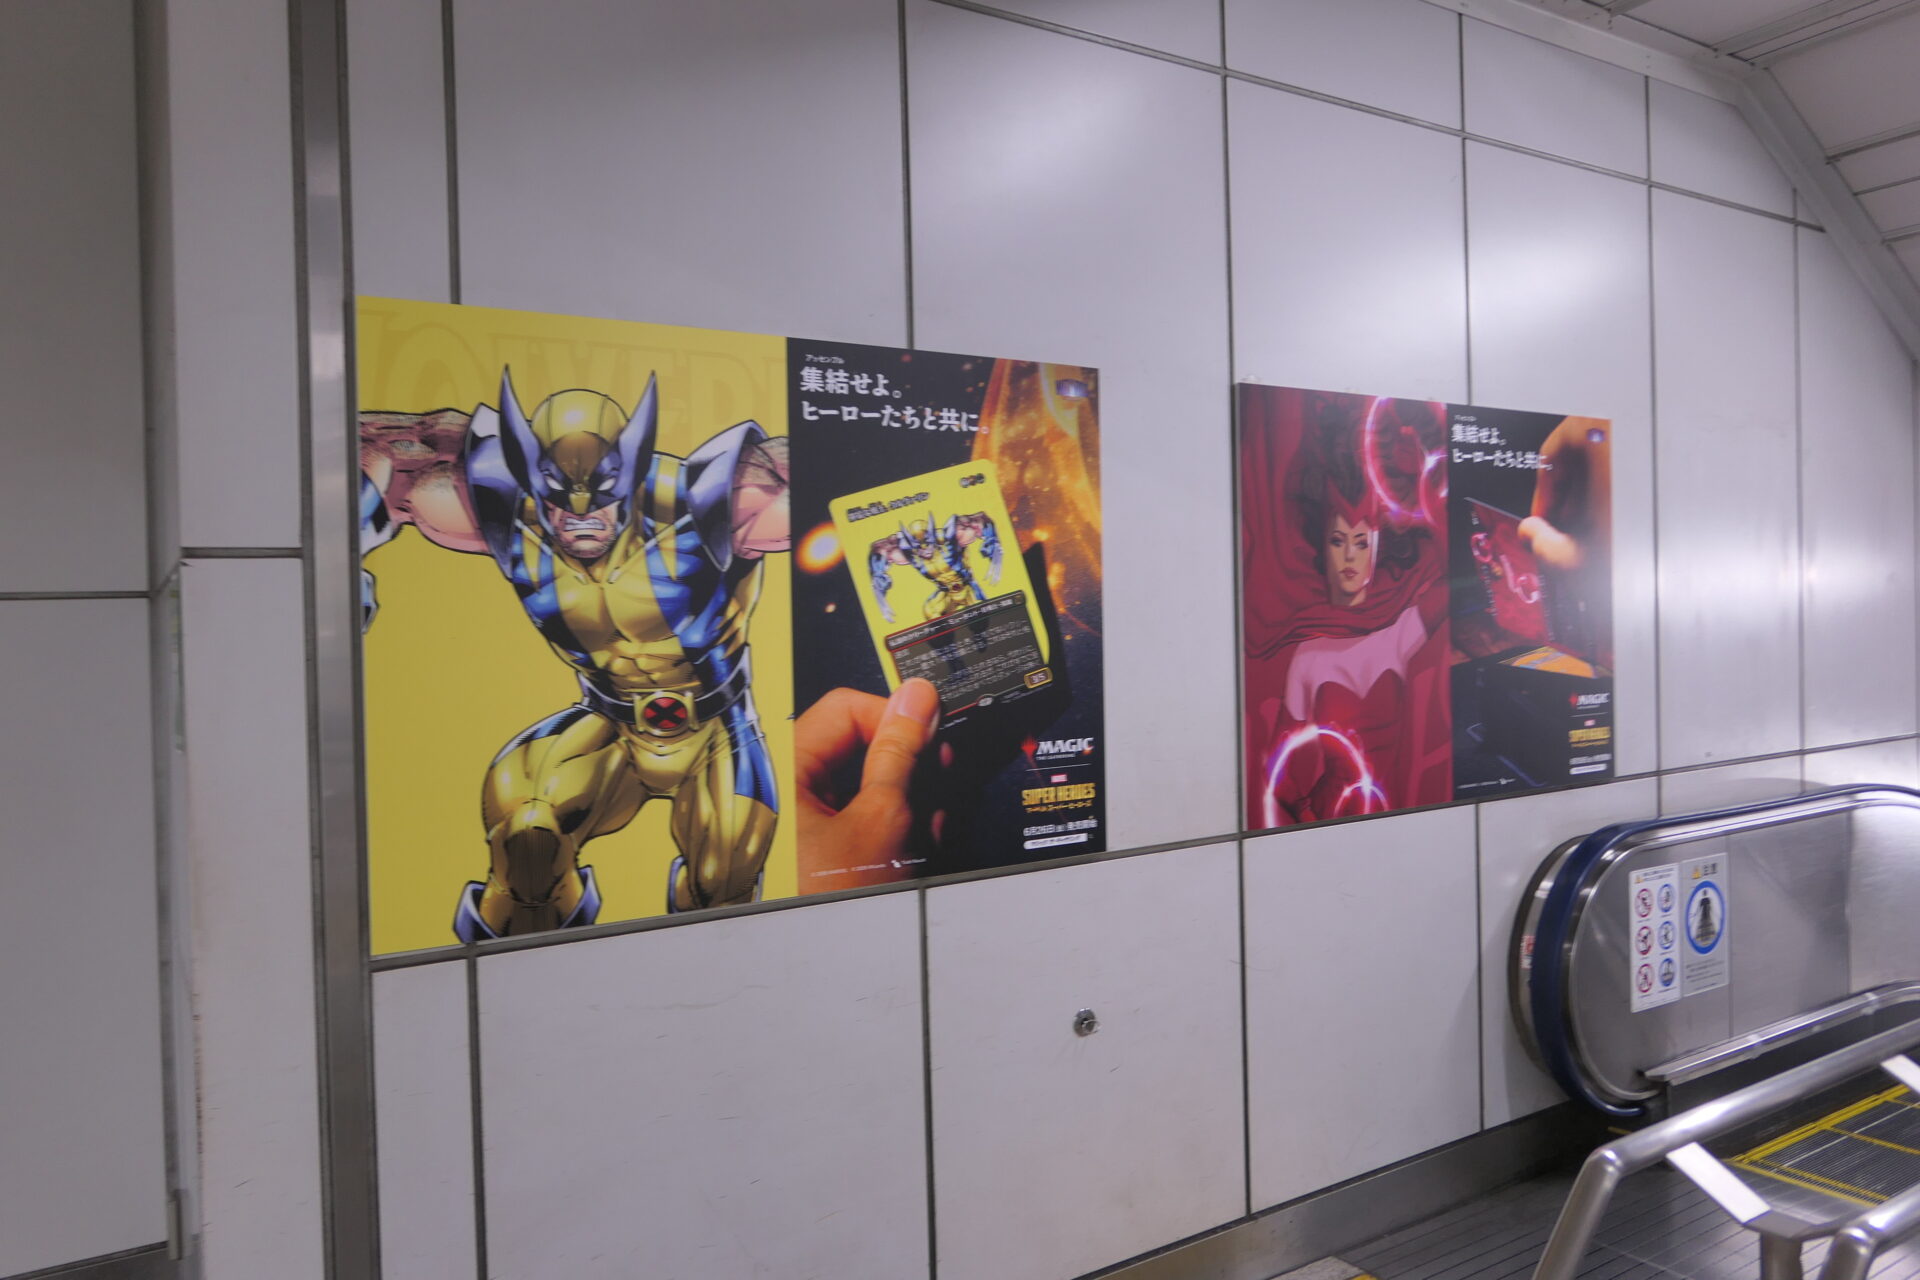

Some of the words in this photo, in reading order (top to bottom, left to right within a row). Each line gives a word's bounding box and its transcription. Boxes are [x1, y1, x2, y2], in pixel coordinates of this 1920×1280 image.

[800, 366, 902, 399] 集結せよ。
[801, 401, 990, 434] ヒーローたちと共に。
[1451, 423, 1507, 446] 集結せよ。
[1452, 448, 1553, 471] ヒーローたちと共に。
[1036, 737, 1094, 755] MAGIC
